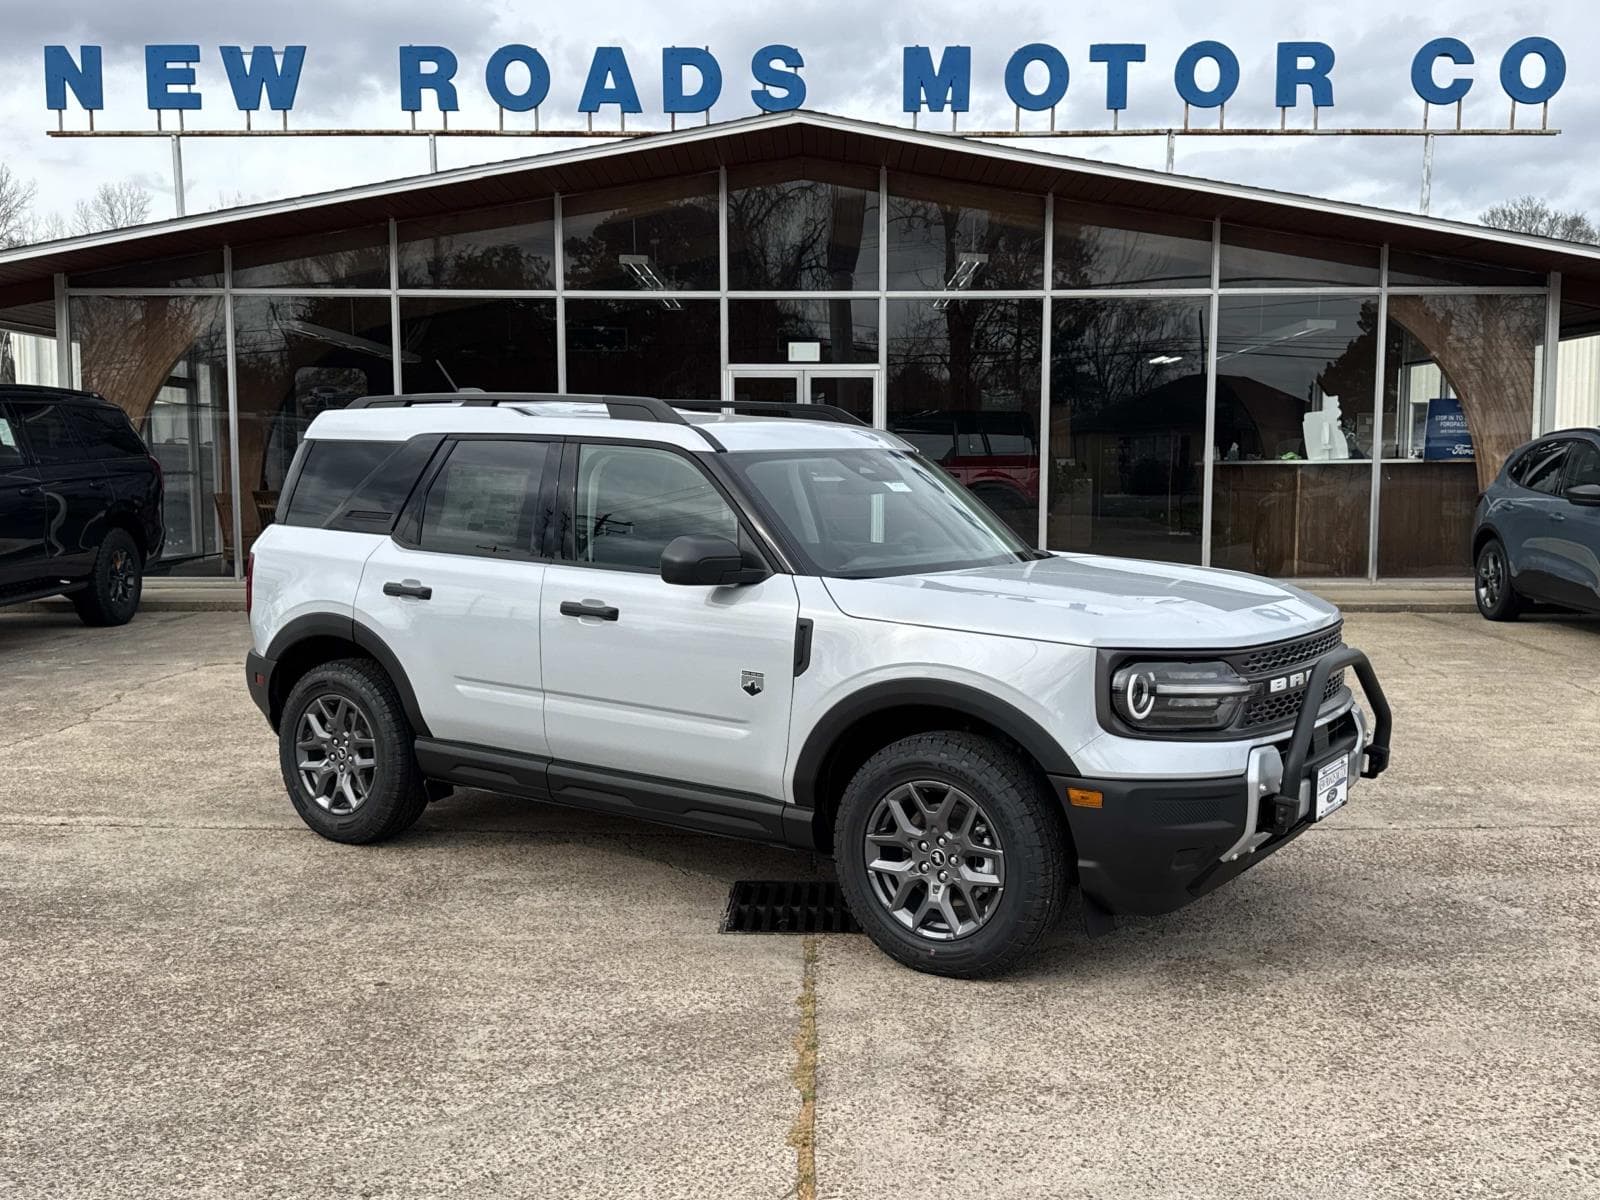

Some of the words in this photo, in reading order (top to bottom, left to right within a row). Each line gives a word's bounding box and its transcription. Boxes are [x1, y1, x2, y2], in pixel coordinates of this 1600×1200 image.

[44, 45, 306, 110] NEW
[399, 44, 806, 113] ROADS
[903, 41, 1335, 112] MOTOR
[1411, 37, 1566, 105] CO
